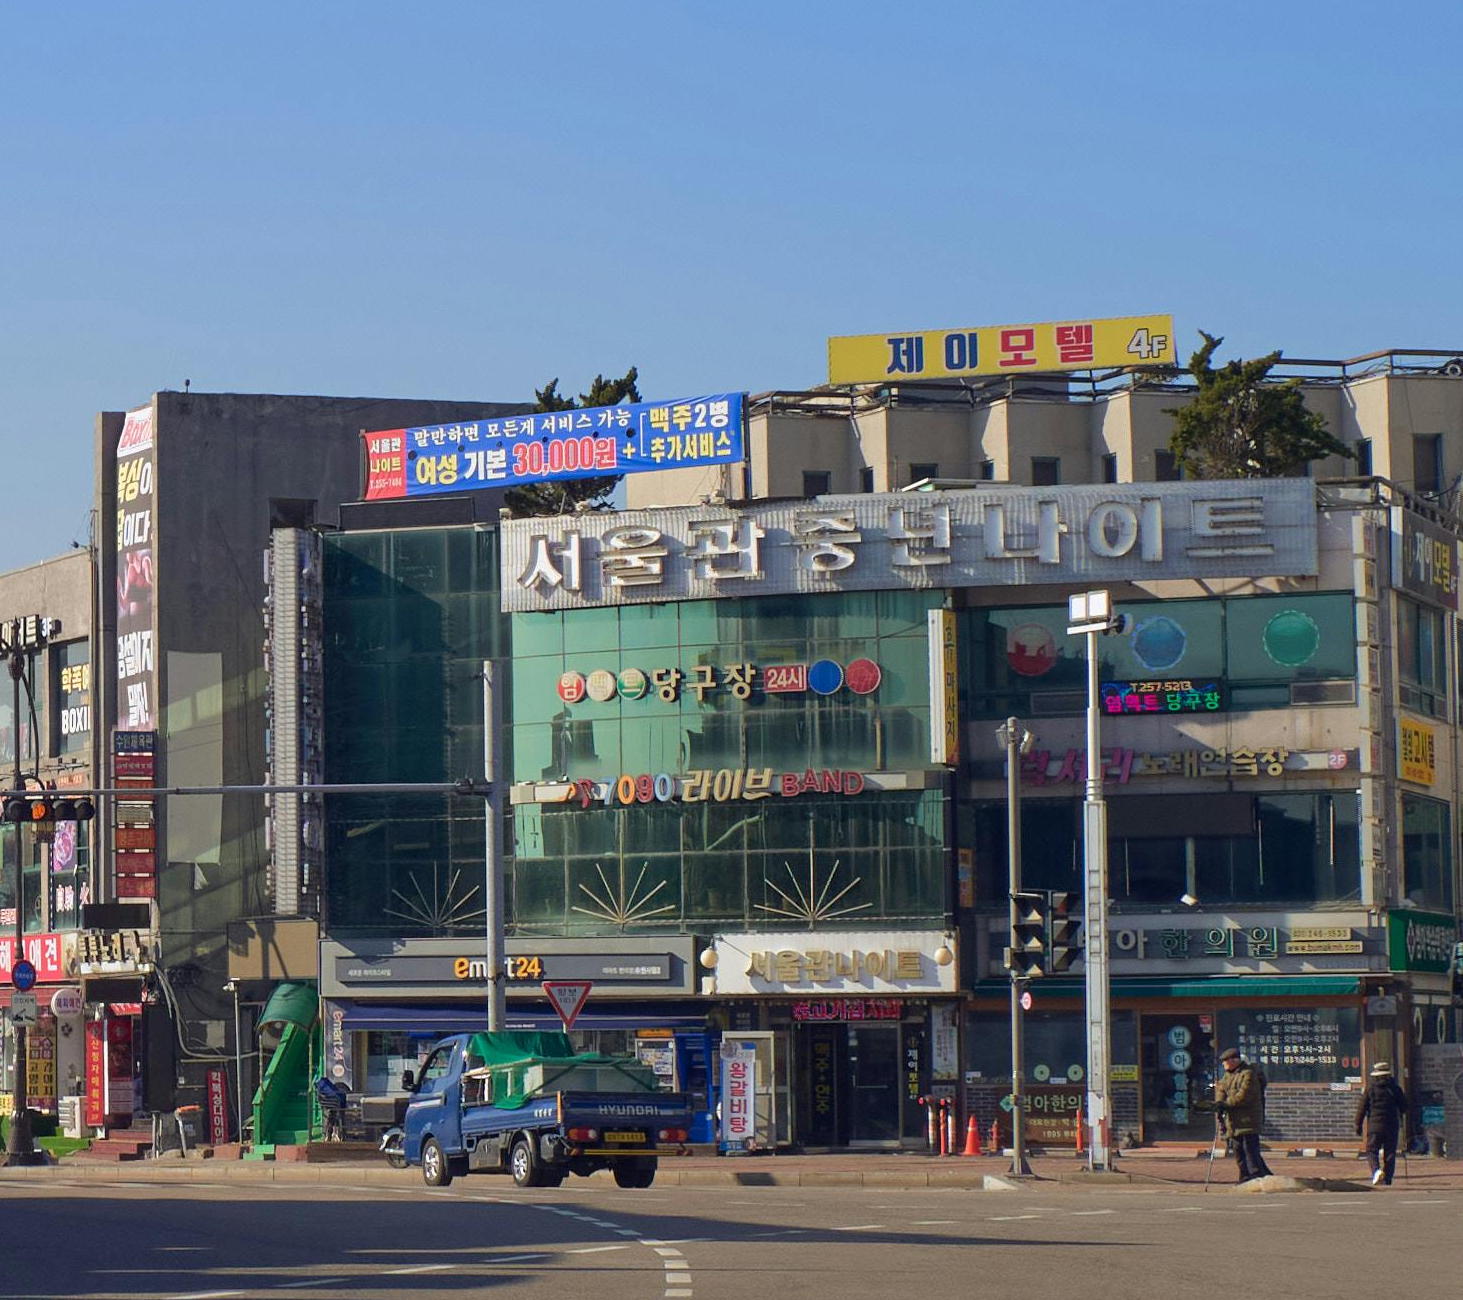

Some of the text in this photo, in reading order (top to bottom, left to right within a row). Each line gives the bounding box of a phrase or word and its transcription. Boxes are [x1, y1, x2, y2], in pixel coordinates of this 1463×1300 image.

[886, 325, 1167, 375] 제이모텔 4F
[415, 408, 632, 448] 말만하면 모든게 서비스 가능
[369, 437, 401, 453] 서울관
[649, 432, 732, 463] 추가서비스
[370, 457, 401, 473] 나이트
[416, 454, 458, 486] 여성
[464, 449, 507, 480] 기본
[511, 436, 618, 477] 30,000원
[41, 617, 53, 637] 3F
[767, 667, 804, 690] 24시
[1166, 691, 1220, 711] 당구장
[1142, 746, 1289, 777] 노래연습장
[1328, 754, 1346, 766] 2F
[604, 767, 865, 806] 7090 라이브 BAND
[0, 937, 58, 972] 해애견
[1076, 926, 1279, 960] 아한의원
[454, 957, 542, 980] emt24
[332, 1010, 344, 1060] emart24
[598, 1105, 659, 1116] HYUNDAI
[730, 1062, 748, 1133] 왕갈비탕
[1022, 1094, 1083, 1113] 아한의
